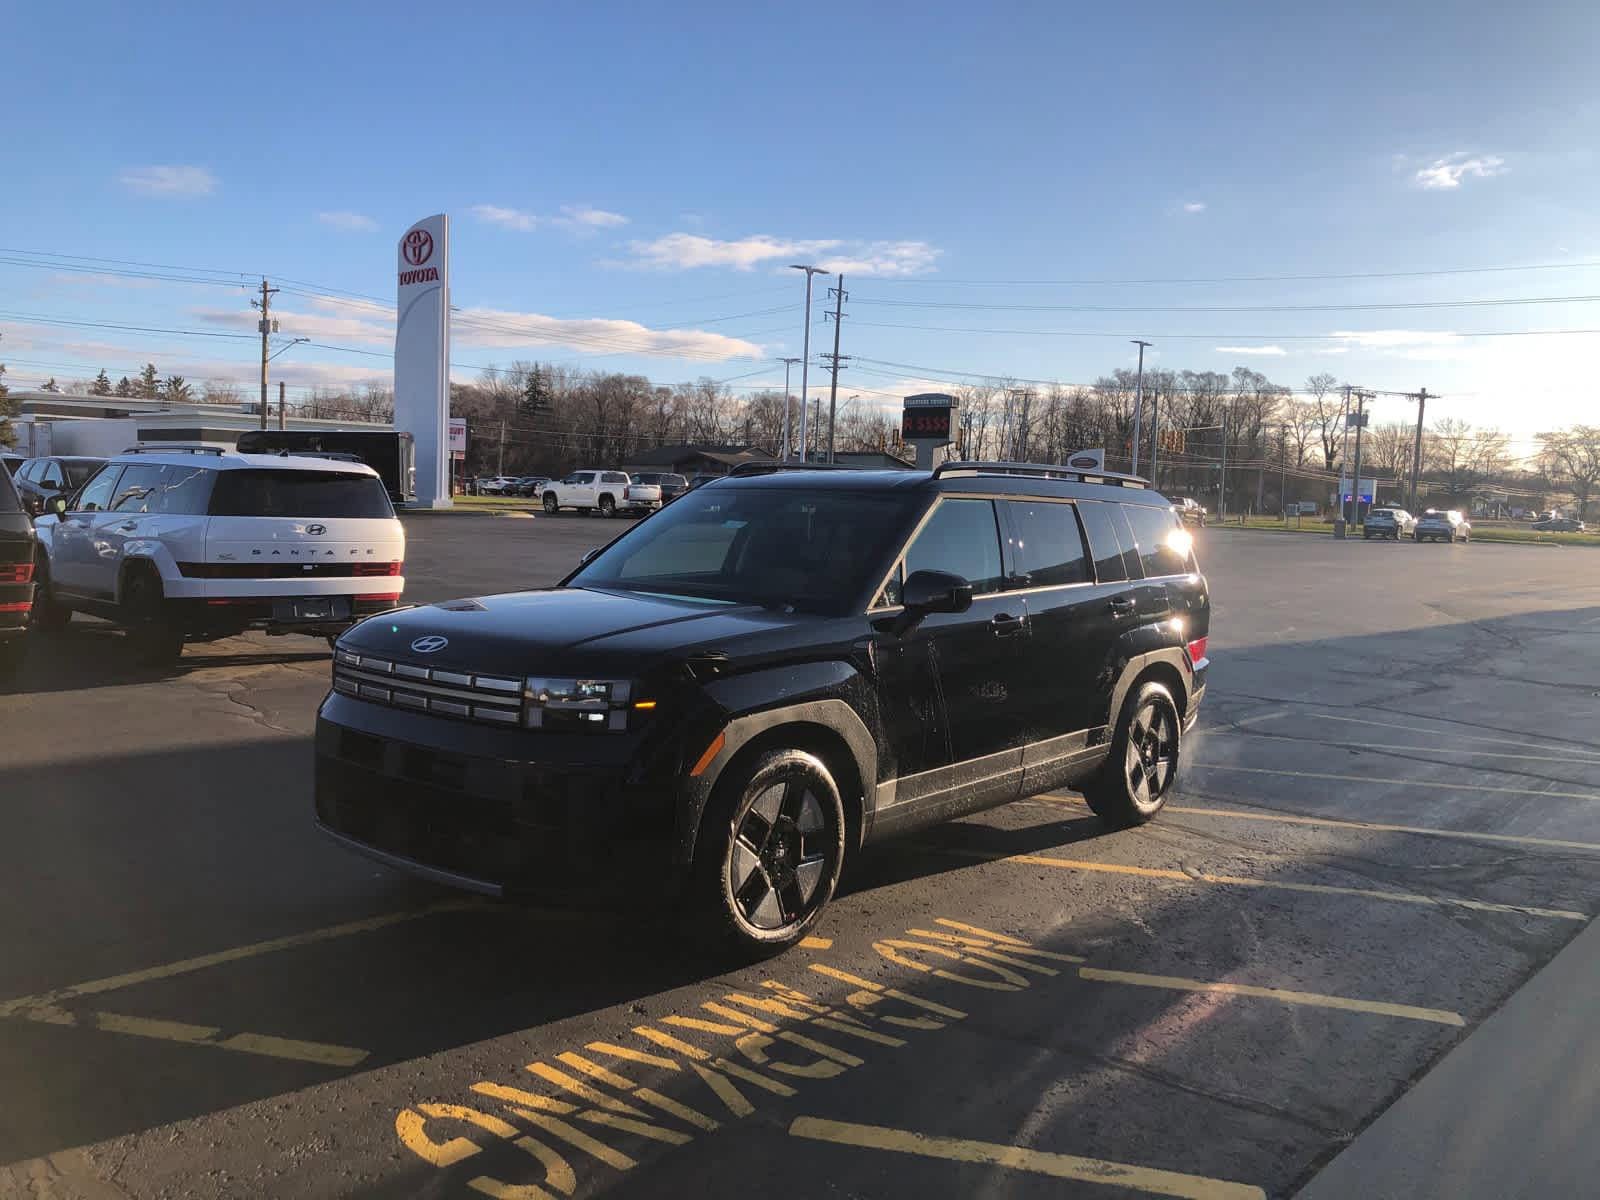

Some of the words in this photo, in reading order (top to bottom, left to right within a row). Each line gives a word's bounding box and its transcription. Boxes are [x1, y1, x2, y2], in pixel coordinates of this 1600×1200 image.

[399, 266, 438, 286] TOYOTA
[251, 548, 335, 556] SANTA
[871, 917, 1084, 991] NO
[394, 963, 970, 1200] PARKING
